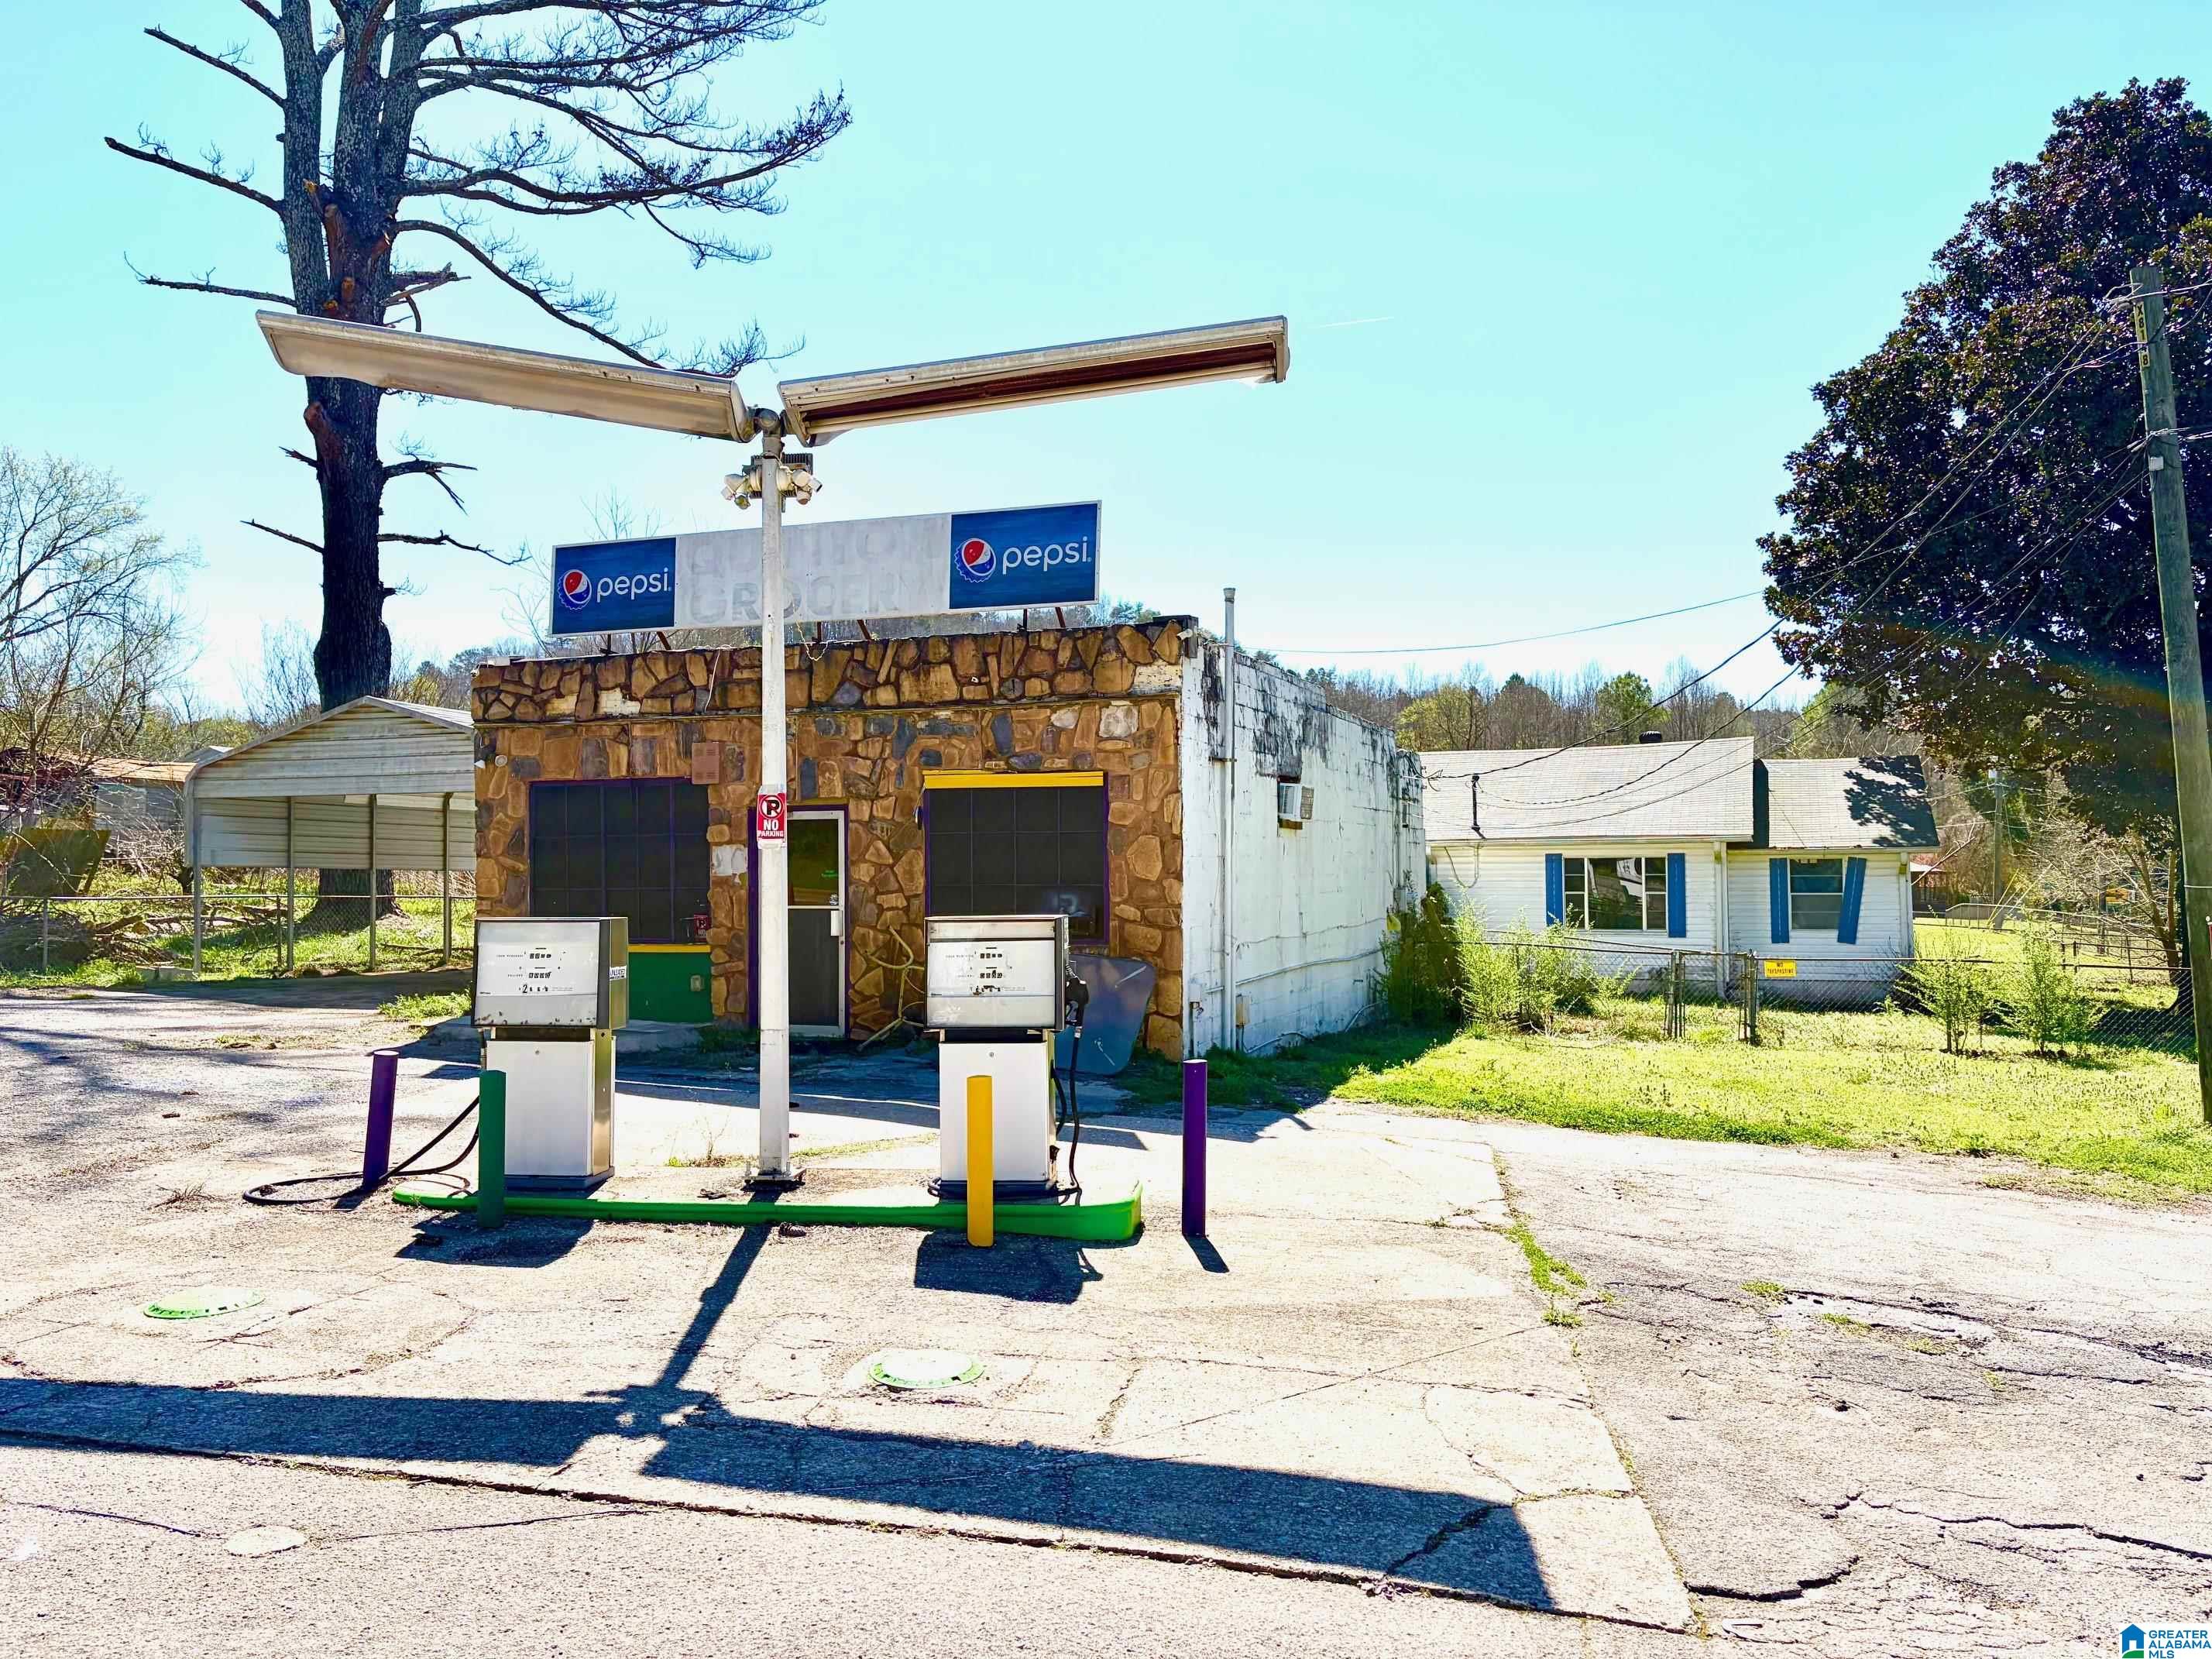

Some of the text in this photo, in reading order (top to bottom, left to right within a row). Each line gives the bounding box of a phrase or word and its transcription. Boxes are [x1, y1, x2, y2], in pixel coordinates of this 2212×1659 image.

[1002, 536, 1088, 575] pepsi
[597, 567, 669, 603] pepsi
[763, 819, 779, 831] NO
